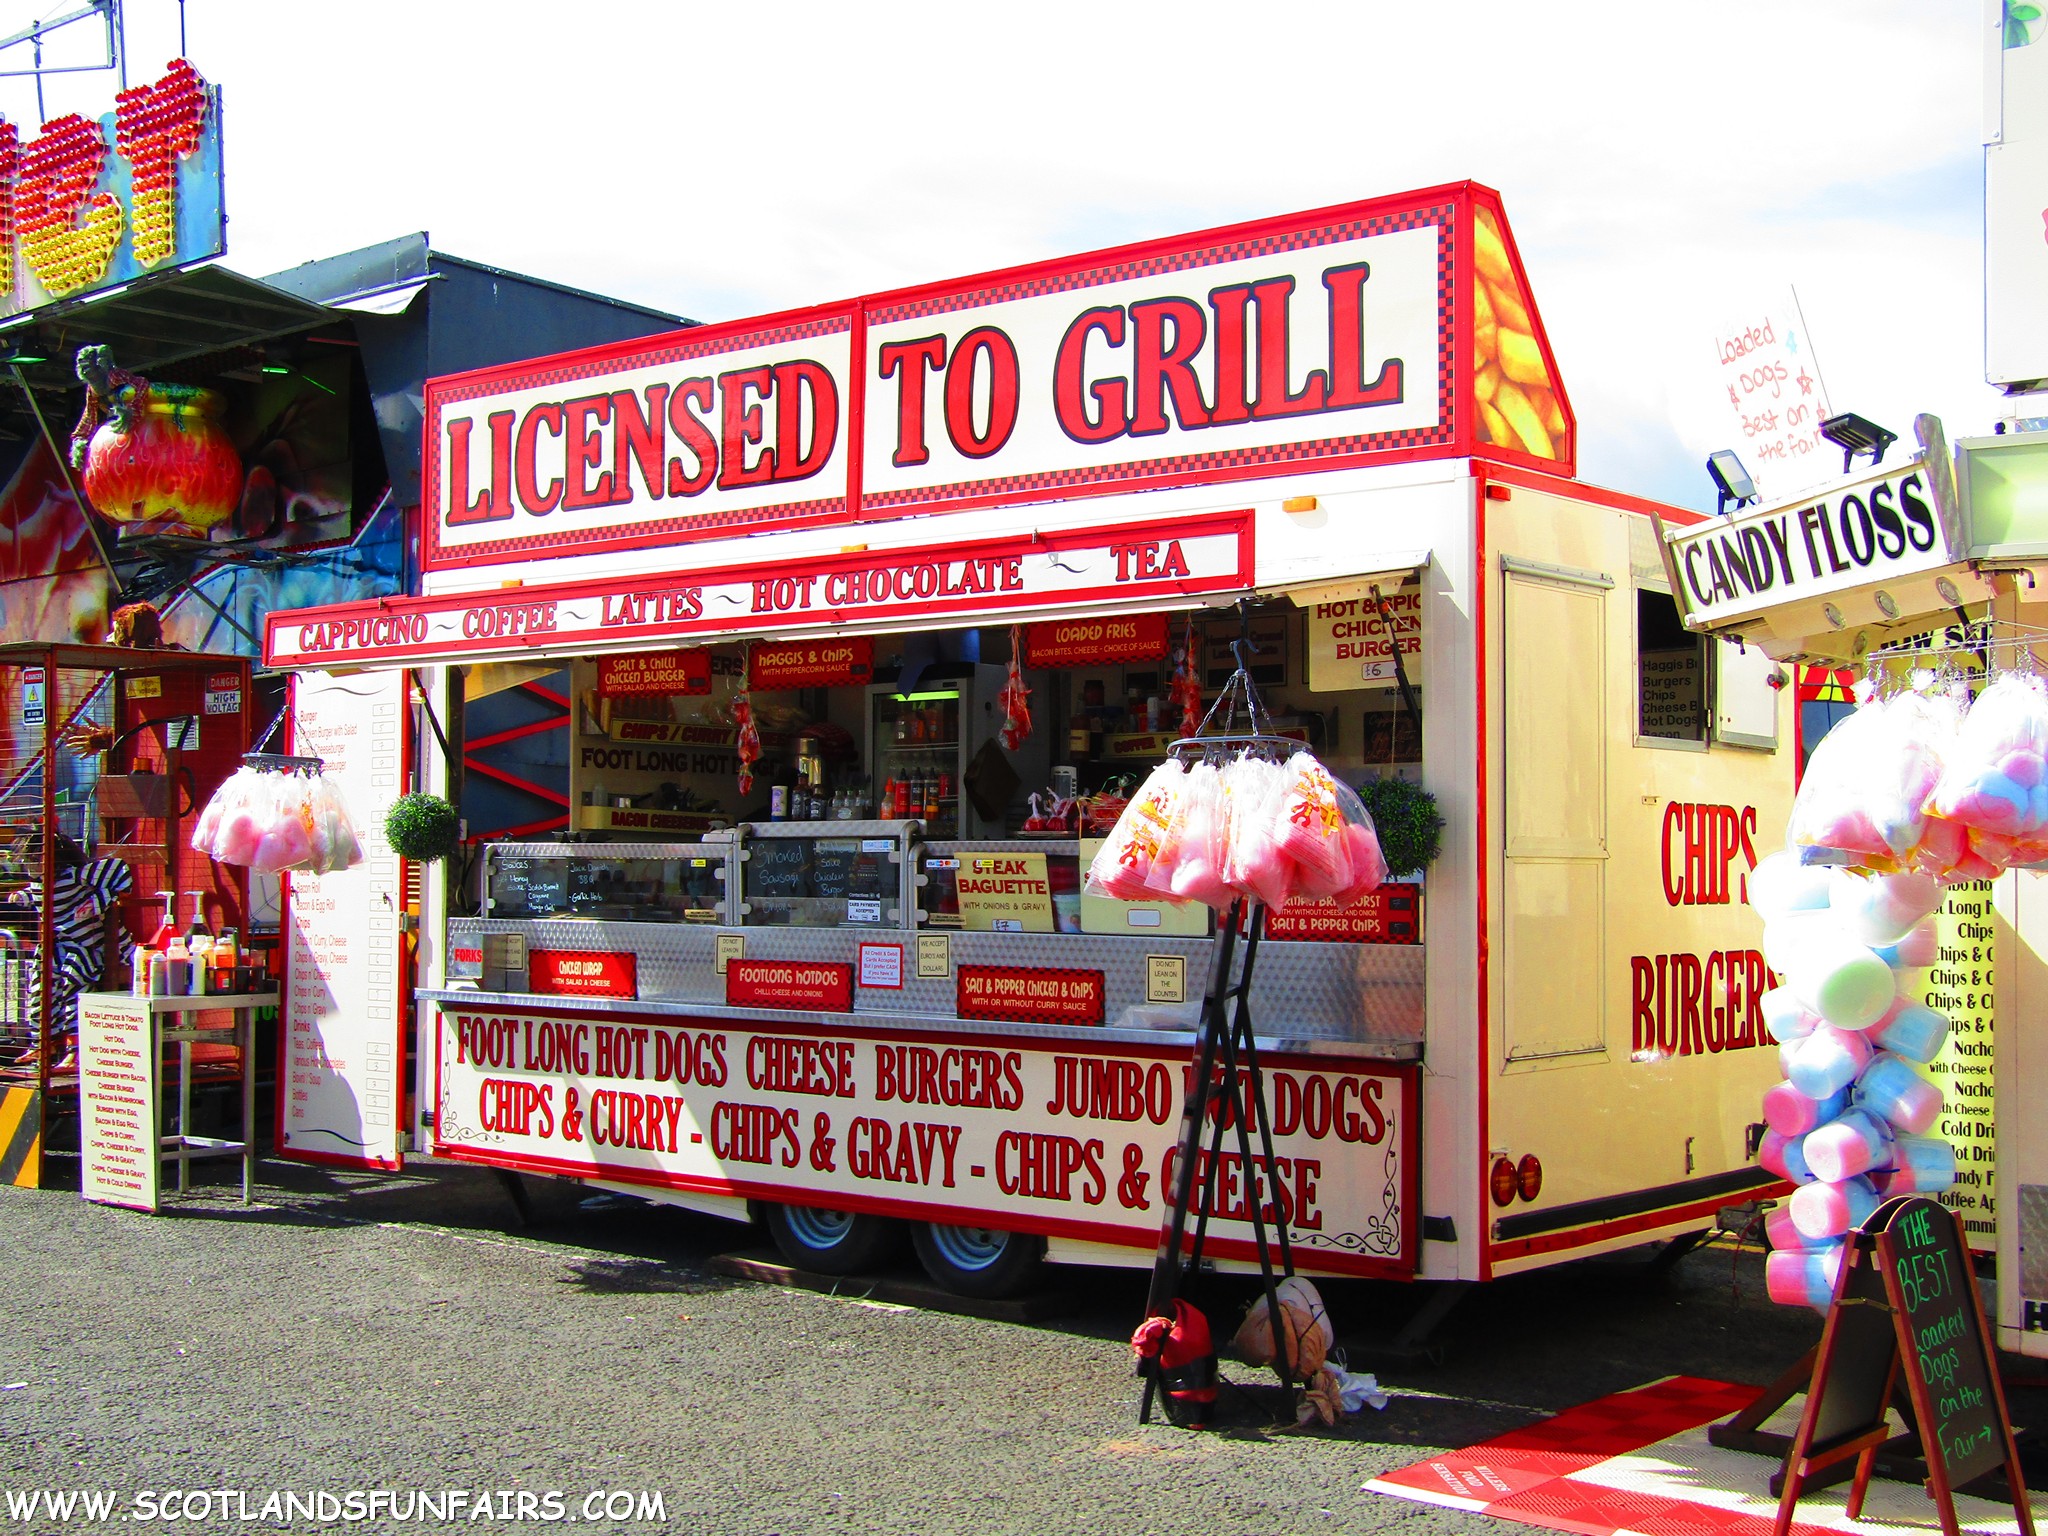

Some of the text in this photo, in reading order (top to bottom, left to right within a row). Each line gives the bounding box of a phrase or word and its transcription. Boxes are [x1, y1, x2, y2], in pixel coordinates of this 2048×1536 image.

[1715, 317, 1776, 365] Loaded
[445, 261, 1404, 527] LICENSED TO GRILL
[1787, 404, 1810, 426] on
[1758, 440, 1787, 463] the
[1684, 473, 1935, 607] CANDY FLOSS
[299, 540, 1190, 652] CAPPUCINO COFFEE LATTES HOT CHOCOLATE TEA
[1317, 598, 1376, 619] HOT &
[1056, 622, 1137, 643] LOADED FRIES
[808, 651, 817, 663] &
[1032, 648, 1055, 657] BACON
[1074, 645, 1099, 654] CHEESE
[1104, 644, 1128, 652] CHOICE
[1129, 642, 1138, 651] OF
[1139, 641, 1161, 650] SAUCE
[613, 659, 636, 672] SALT
[639, 659, 647, 670] &
[762, 663, 850, 676] WITH PEPPERCORN SAUCE
[1643, 659, 1683, 672] Haggis
[210, 676, 240, 687] DANGER
[644, 669, 686, 683] BURGER
[1643, 676, 1691, 688] Burgers
[623, 683, 644, 691] SALAD
[645, 682, 660, 690] AND
[661, 681, 685, 689] CHEESE
[213, 693, 236, 703] HIGH
[1643, 690, 1676, 702] Chips
[1642, 702, 1687, 714] Cheese
[1642, 714, 1697, 727] Hot Dogs
[581, 748, 728, 775] FOOT LONG HOT
[1662, 800, 1758, 907] CHIPS
[959, 879, 1047, 895] BAGUETTE
[963, 902, 980, 910] WITH
[983, 902, 1010, 910] ONIONS
[1021, 903, 1046, 911] GRAVY
[1948, 900, 1981, 918] Long
[1272, 918, 1295, 930] SALT
[1299, 918, 1307, 930] &
[1311, 918, 1349, 931] PEPPER
[1957, 922, 1994, 942] Chips
[455, 948, 483, 962] FORKS
[565, 978, 582, 986] SALAD
[589, 979, 611, 987] CHEESE
[1929, 969, 1967, 988] Chips
[771, 988, 790, 997] CHEESE
[791, 989, 803, 997] AND
[804, 990, 823, 998] ONIONS
[965, 977, 984, 994] SALT
[985, 978, 992, 994] &
[994, 978, 1025, 997] PEPPER
[1061, 981, 1068, 997] &
[1154, 990, 1178, 998] COUNTER
[971, 998, 1087, 1010] WITH OR WITHOUT CURRY SAUCE
[1925, 993, 1962, 1011] Chips
[1929, 1062, 1986, 1075] with Cheese
[457, 1016, 520, 1068] FOOT
[524, 1020, 588, 1074] LONG
[595, 1025, 648, 1080] HOT
[654, 1030, 728, 1088] DOGS
[746, 1036, 856, 1098] CHEESE
[875, 1045, 1023, 1111] BURGERS
[1047, 1056, 1172, 1126] JUMBO
[1272, 1072, 1386, 1146] DOGS
[1955, 1102, 1989, 1116] Cheese
[1941, 1120, 1971, 1137] Cold
[479, 1077, 1323, 1231] CHIPS & CURRY CHIPS & GRAVY CHIPS & CHEESE
[1897, 1207, 1936, 1248] THE
[1897, 1249, 1949, 1313] BEST
[1939, 1387, 1982, 1418] on the
[1938, 1422, 1976, 1468] Fair
